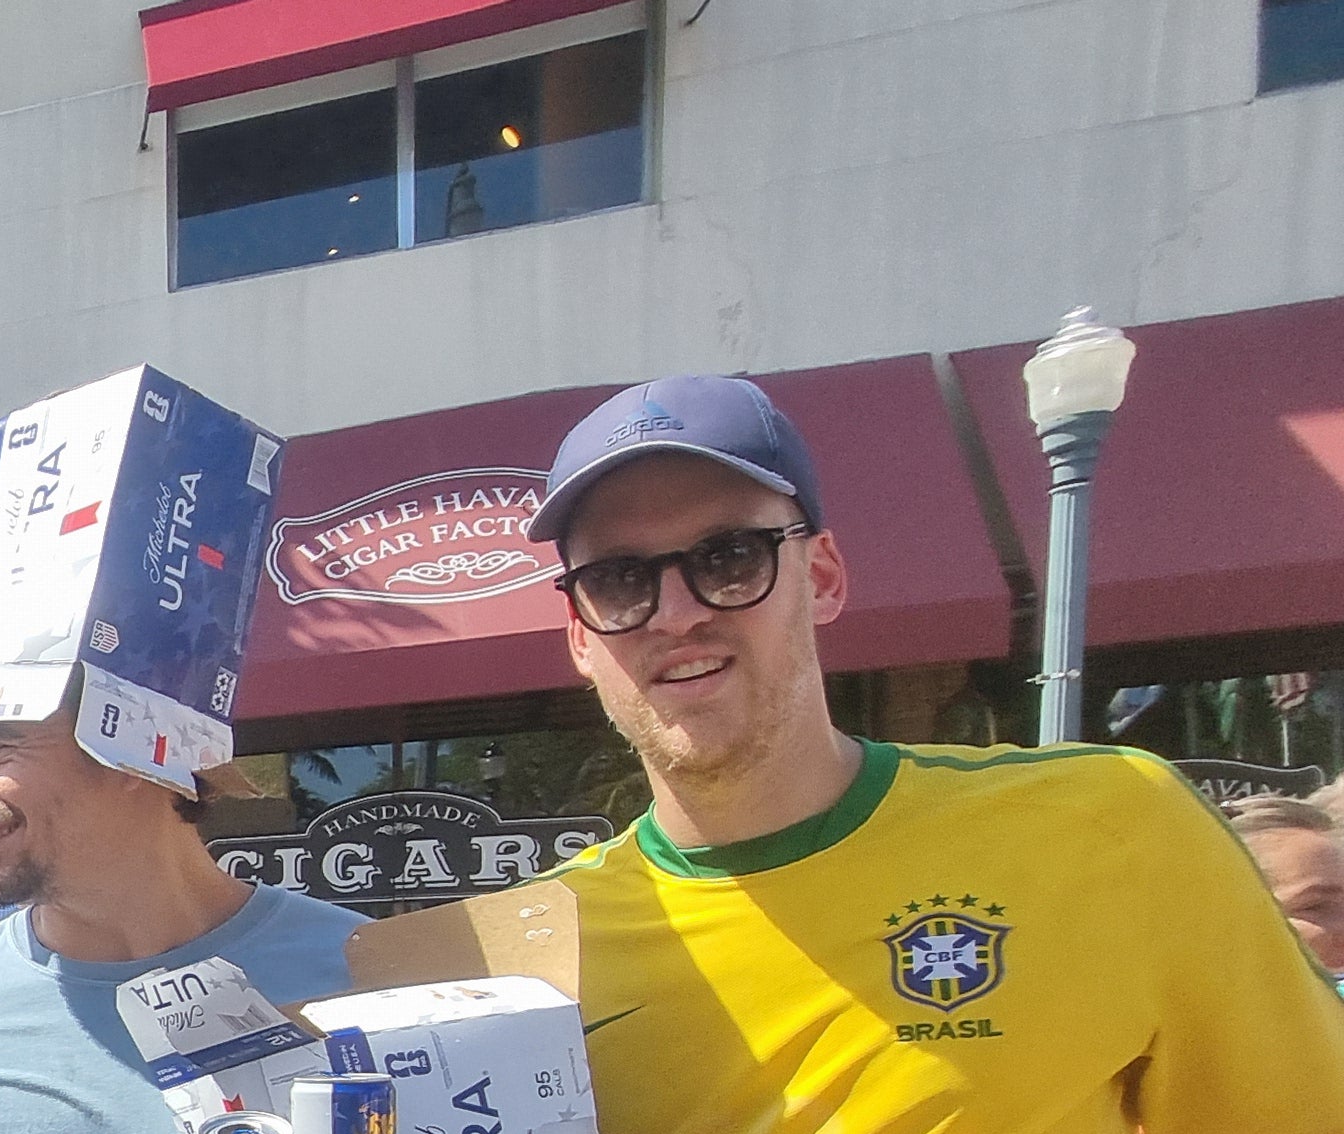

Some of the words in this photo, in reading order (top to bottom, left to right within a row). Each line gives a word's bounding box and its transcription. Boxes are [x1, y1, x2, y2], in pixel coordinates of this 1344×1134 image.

[604, 415, 684, 448] adidas
[142, 481, 172, 586] Michelob
[159, 470, 202, 612] ULTRA
[297, 500, 424, 562] LITTLE
[433, 486, 541, 516] HAVA
[324, 531, 423, 580] CIGAR
[431, 515, 530, 544] FACTO
[91, 621, 104, 650] USA
[324, 802, 482, 838] HANDMADE
[217, 831, 595, 893] CIGARS
[924, 951, 964, 964] CBF
[895, 1018, 1004, 1042] BRASIL
[535, 1070, 552, 1099] 95
